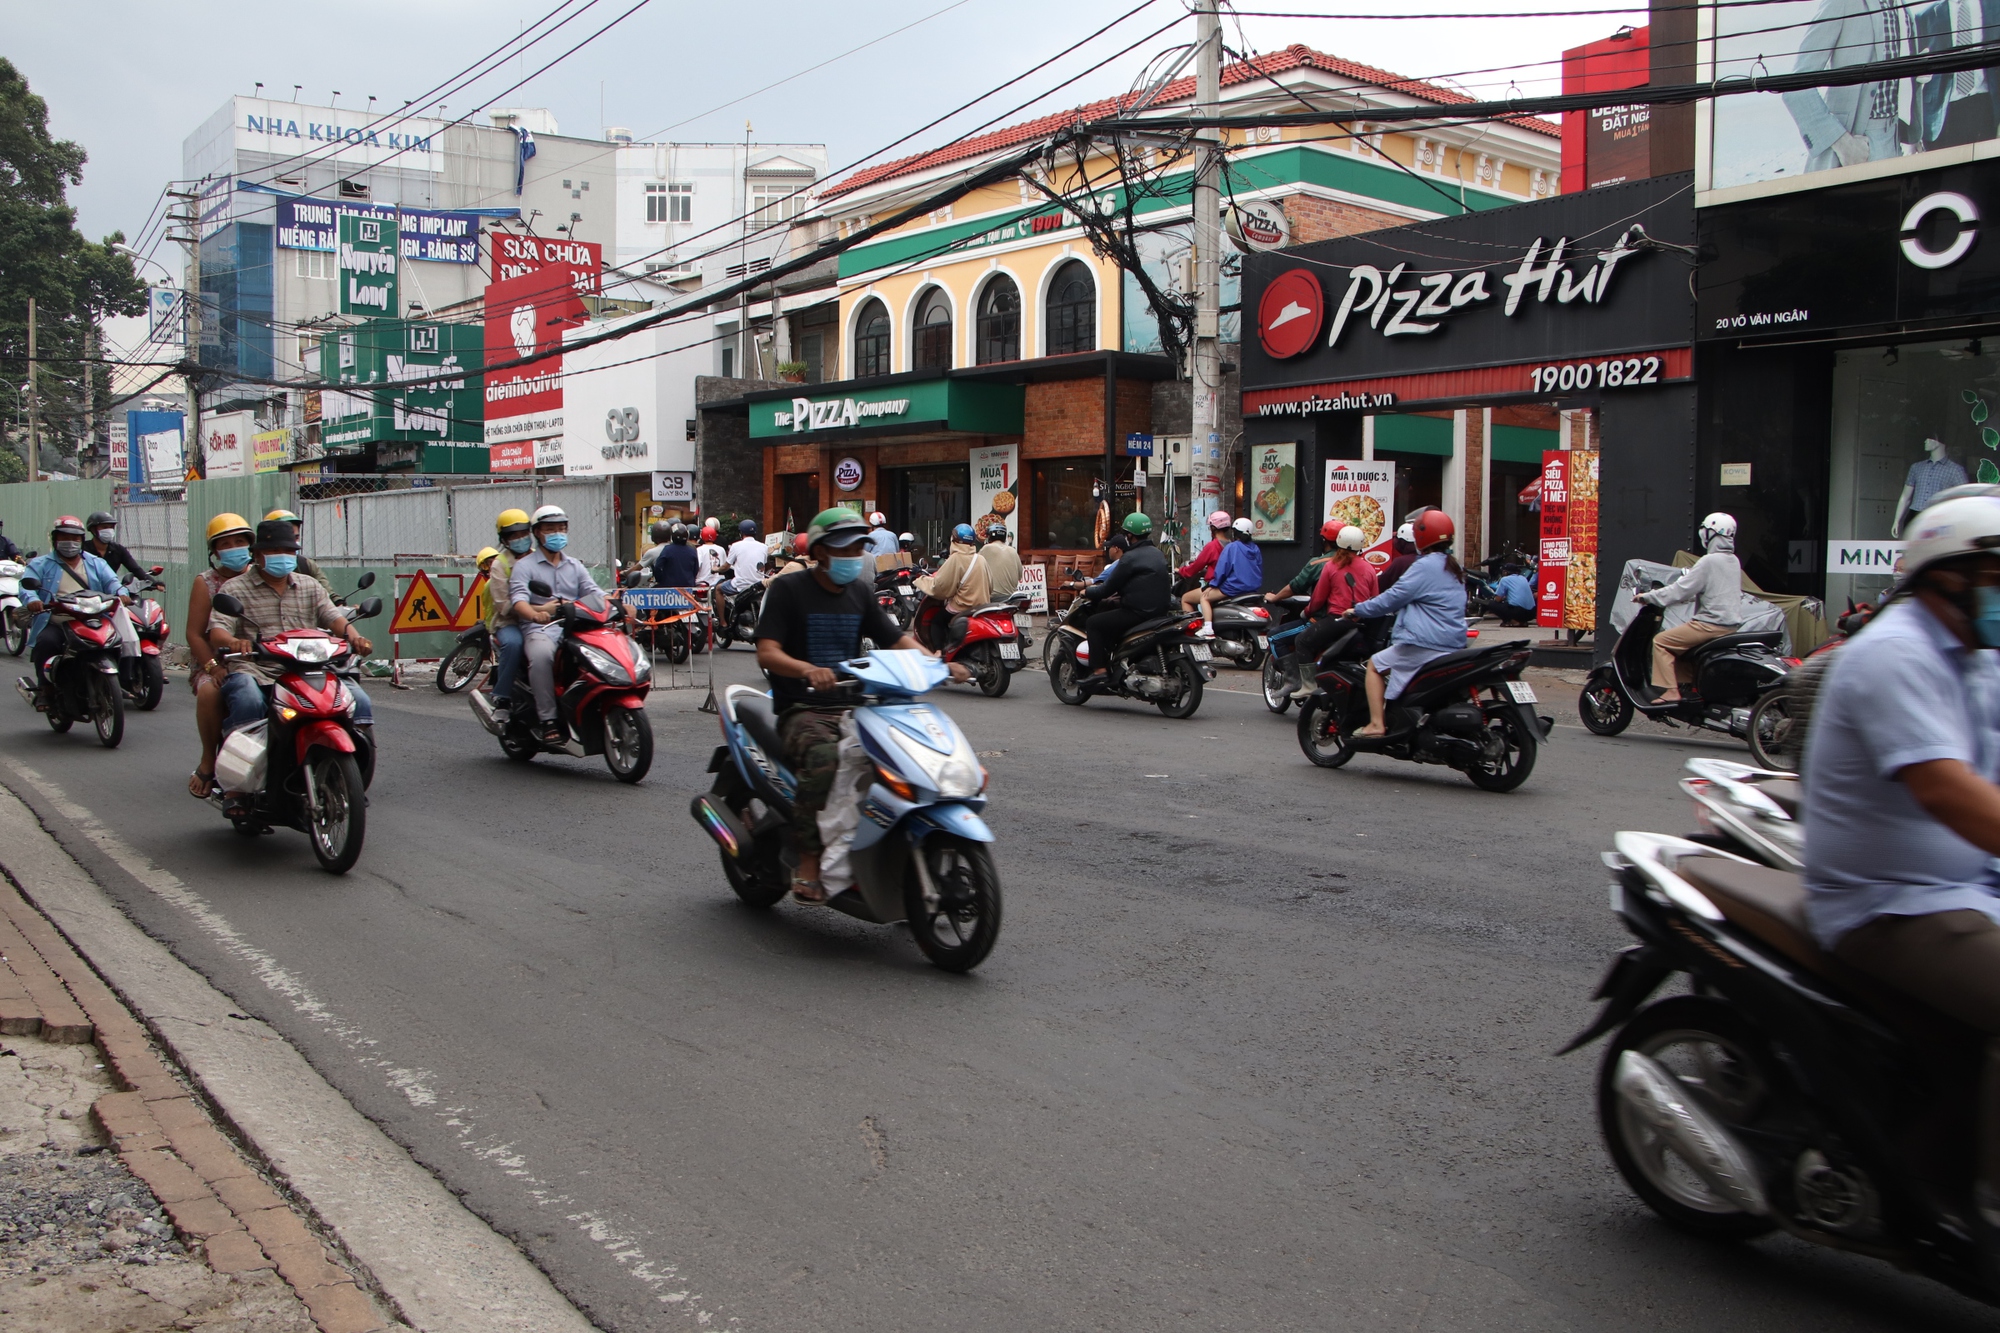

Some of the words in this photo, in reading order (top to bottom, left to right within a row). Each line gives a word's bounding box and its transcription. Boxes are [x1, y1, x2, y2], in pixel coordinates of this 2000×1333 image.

[1602, 114, 1628, 132] ĐẶT
[248, 114, 301, 139] NHA
[309, 121, 380, 149] KHOA
[388, 132, 432, 154] KIM
[1614, 128, 1631, 140] MUA
[293, 204, 331, 224] TRUNG
[420, 216, 468, 236] IMPLANT
[1258, 209, 1268, 218] The
[1030, 212, 1062, 233] 1900
[1246, 212, 1279, 234] PIZZA
[280, 223, 316, 248] NIỀNG
[428, 238, 457, 260] RĂNG
[460, 242, 476, 262] SỨ
[1252, 232, 1274, 242] Company
[341, 242, 396, 276] Nguyễn
[504, 236, 540, 260] SỬA
[544, 243, 592, 266] CHỮA
[350, 277, 388, 311] Long
[1328, 262, 1490, 348] Pizza
[1504, 231, 1651, 317] Hut
[1716, 318, 1728, 329] 20
[1731, 314, 1746, 327] VÕ
[1750, 312, 1771, 326] VĂN
[1774, 308, 1808, 323] NGÂN
[1530, 364, 1592, 394] 1900
[1594, 356, 1660, 388] 1822
[1258, 390, 1393, 418] www.pizzahut.vn
[394, 398, 448, 438] Long
[774, 412, 790, 426] The
[792, 397, 858, 432] PIZZA
[856, 399, 908, 418] Company
[491, 423, 504, 436] THỐNG
[504, 424, 512, 435] SỬA
[512, 421, 523, 433] CHỮA
[524, 420, 534, 432] ĐIỆN
[605, 406, 639, 443] GB
[112, 440, 127, 453] ĐỨC
[1128, 437, 1142, 449] HẺM
[1143, 441, 1151, 450] 24
[113, 457, 127, 468] ANH
[1262, 462, 1280, 470] BOX
[839, 468, 858, 477] PIZZA
[980, 467, 1001, 479] MUA
[1001, 463, 1009, 488] 1
[1331, 472, 1349, 480] MUA
[1351, 472, 1355, 480] 1
[1357, 472, 1380, 483] ĐƯỢC
[1545, 466, 1561, 479] SIÊU
[662, 477, 683, 489] GB
[980, 478, 1002, 492] TẶNG
[1331, 480, 1346, 493] QUÁ
[1348, 481, 1358, 492] LÀ
[1544, 480, 1564, 490] PIZZA
[1544, 491, 1548, 502] 1
[1544, 514, 1563, 523] KHÔNG
[1549, 548, 1568, 558] 668K
[1840, 548, 1902, 566] MIN
[622, 592, 644, 606] ÔNG
[646, 590, 689, 606] TRƯỜNG
